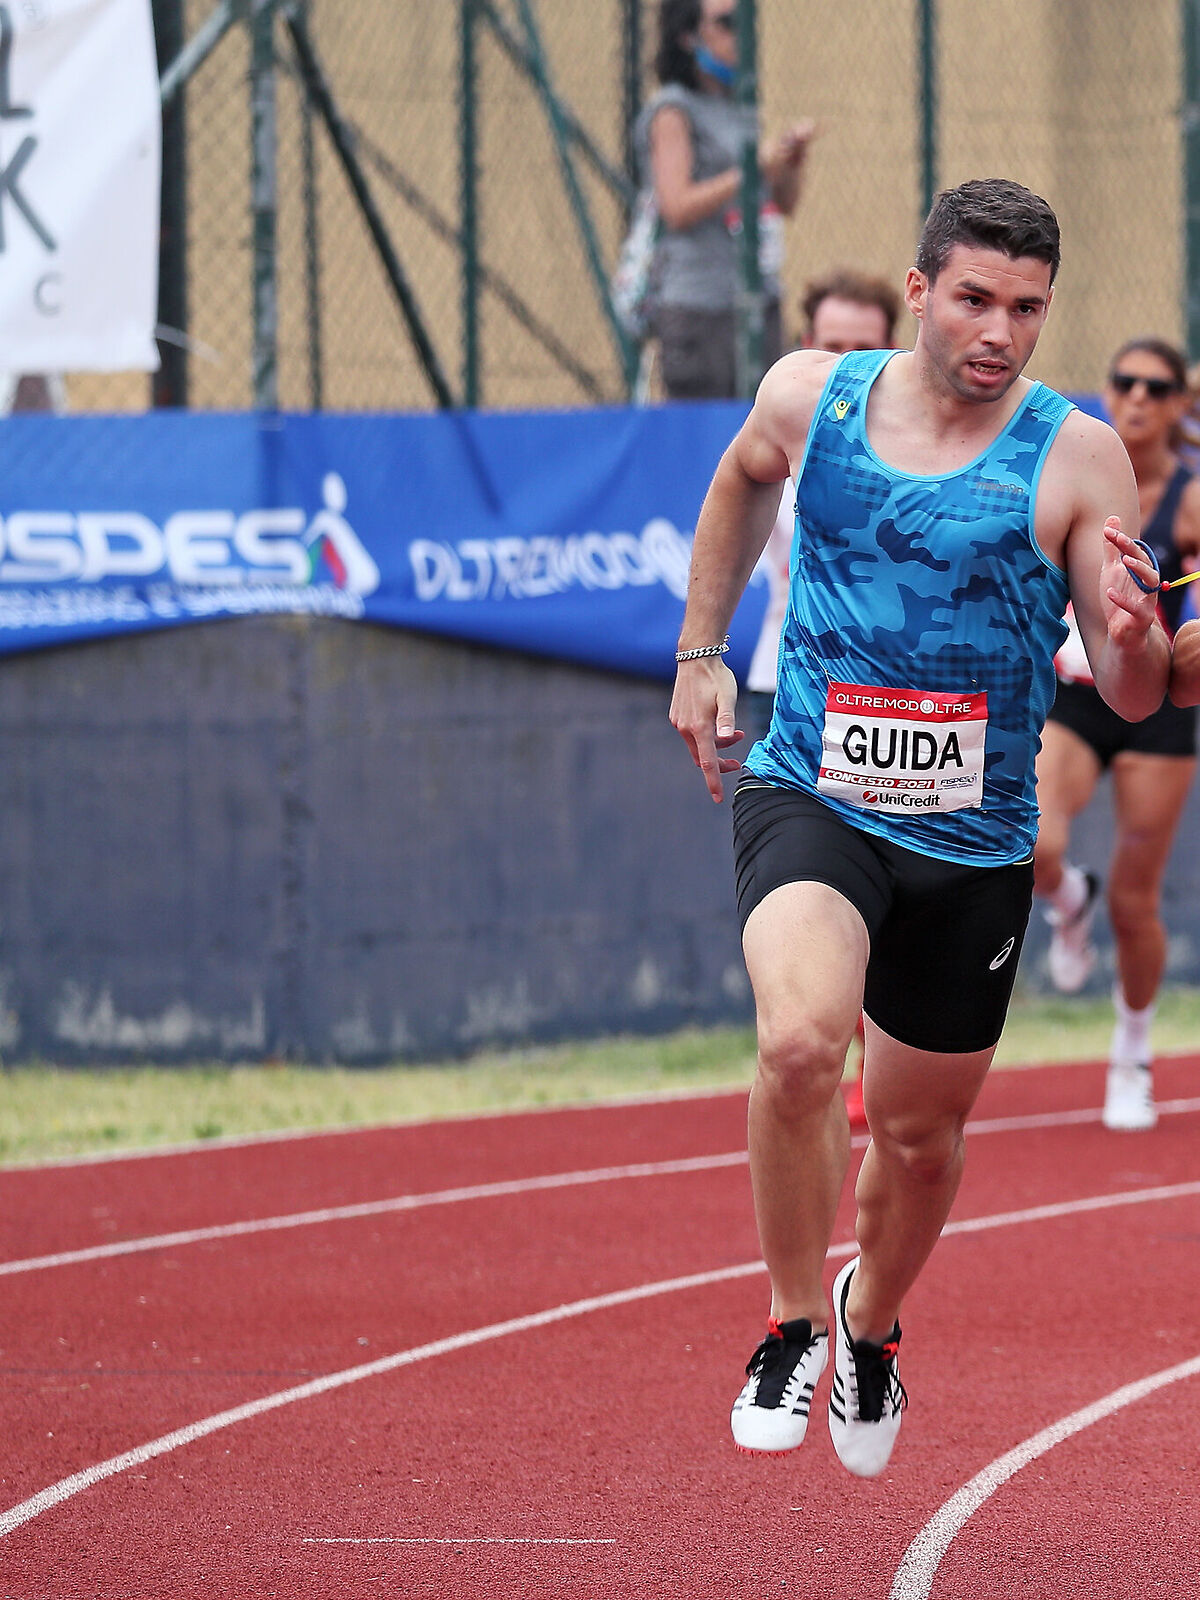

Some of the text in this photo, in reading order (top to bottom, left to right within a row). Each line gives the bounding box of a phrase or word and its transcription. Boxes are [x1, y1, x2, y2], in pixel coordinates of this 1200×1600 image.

[0, 508, 312, 583] SPES
[835, 692, 972, 715] OLTREMODOLTRE
[842, 724, 964, 771] GUIDA
[825, 770, 896, 788] CONCESIO
[896, 779, 933, 789] 2021
[879, 792, 941, 807] UniCredit
